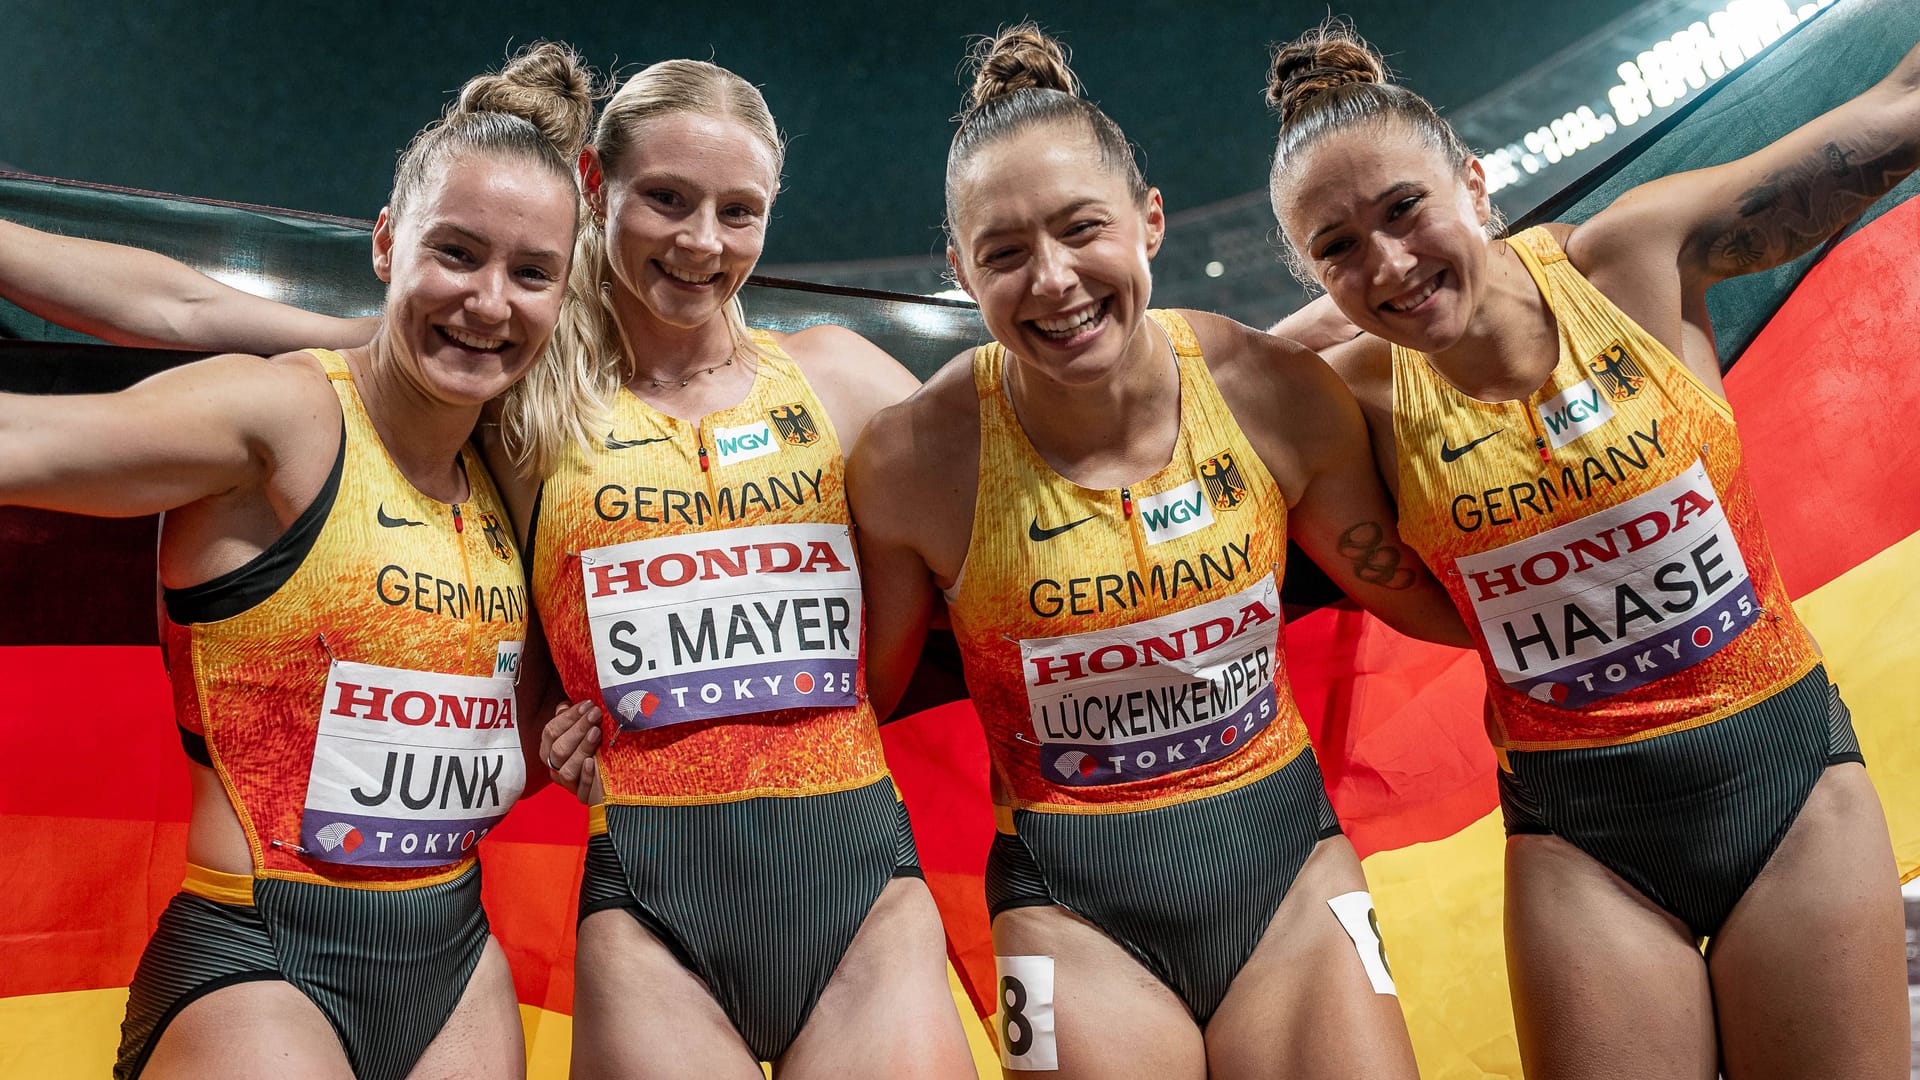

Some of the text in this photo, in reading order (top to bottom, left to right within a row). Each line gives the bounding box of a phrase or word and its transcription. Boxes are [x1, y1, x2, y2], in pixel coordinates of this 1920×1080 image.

[716, 428, 770, 457] WGV
[1544, 389, 1601, 436] WGV
[594, 469, 822, 525] GERMANY
[1142, 491, 1202, 533] WGV
[1451, 418, 1666, 533] GERMANY
[588, 541, 850, 598] HONDA
[1029, 534, 1252, 618] GERMANY
[1468, 489, 1714, 602] HONDA
[609, 597, 850, 676] S. MAYER
[1502, 534, 1733, 671] HAASE
[1030, 600, 1276, 687] HONDA
[330, 681, 515, 730] HONDA
[1041, 646, 1270, 740] LÜCKENKEMPER
[350, 750, 504, 811] JUNK
[1000, 975, 1033, 1057] 8
